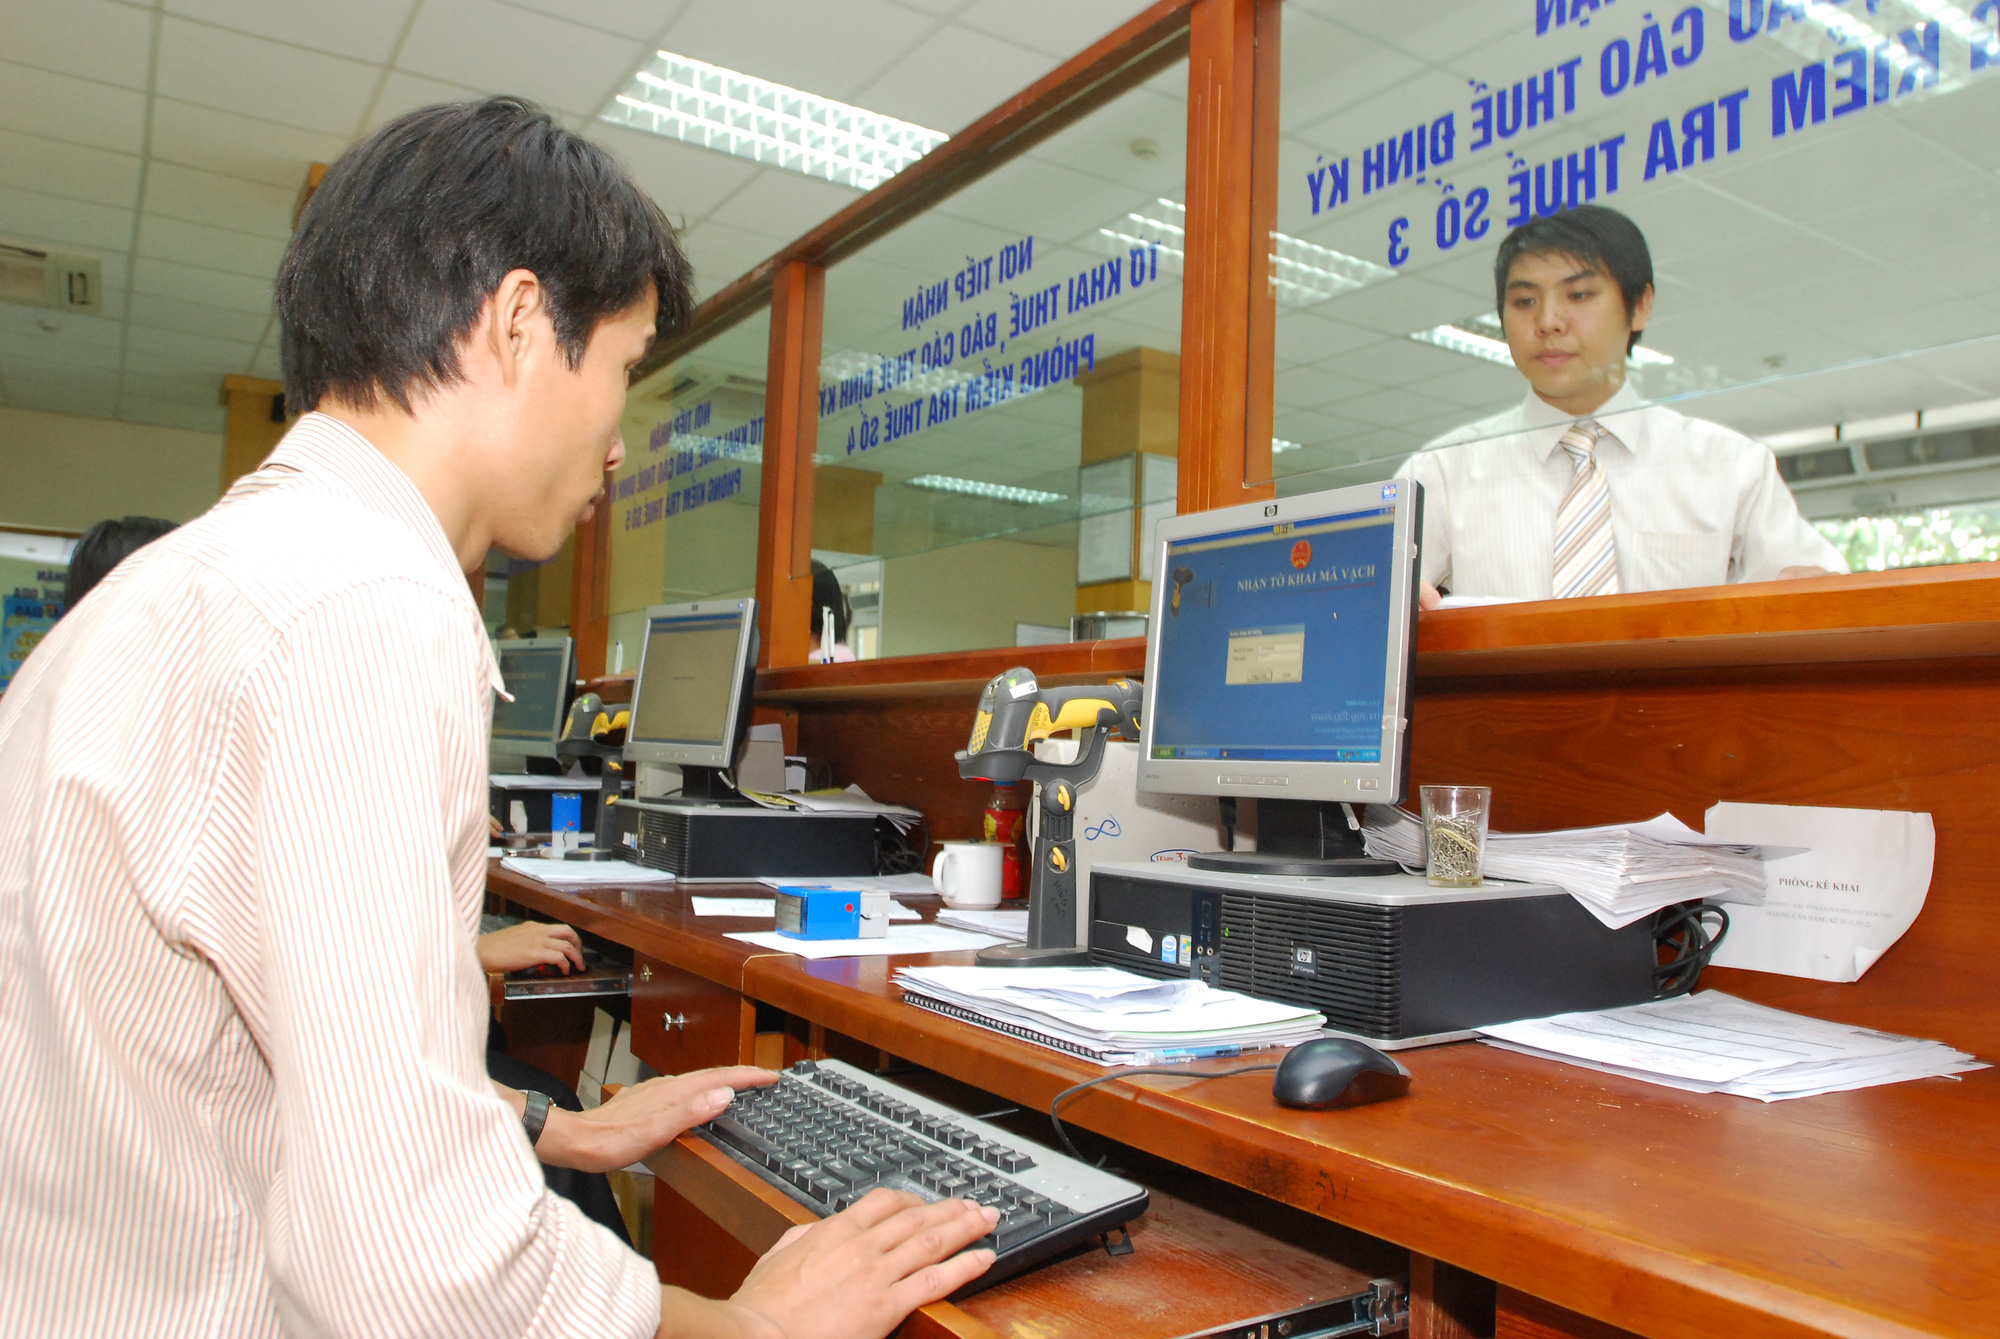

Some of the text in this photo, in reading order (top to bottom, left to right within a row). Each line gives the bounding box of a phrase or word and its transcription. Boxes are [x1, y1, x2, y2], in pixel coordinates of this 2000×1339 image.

[1238, 565, 1376, 593] NHẬN TỜ KHAI MÃ VẠCH
[1833, 882, 1860, 893] KHAI
